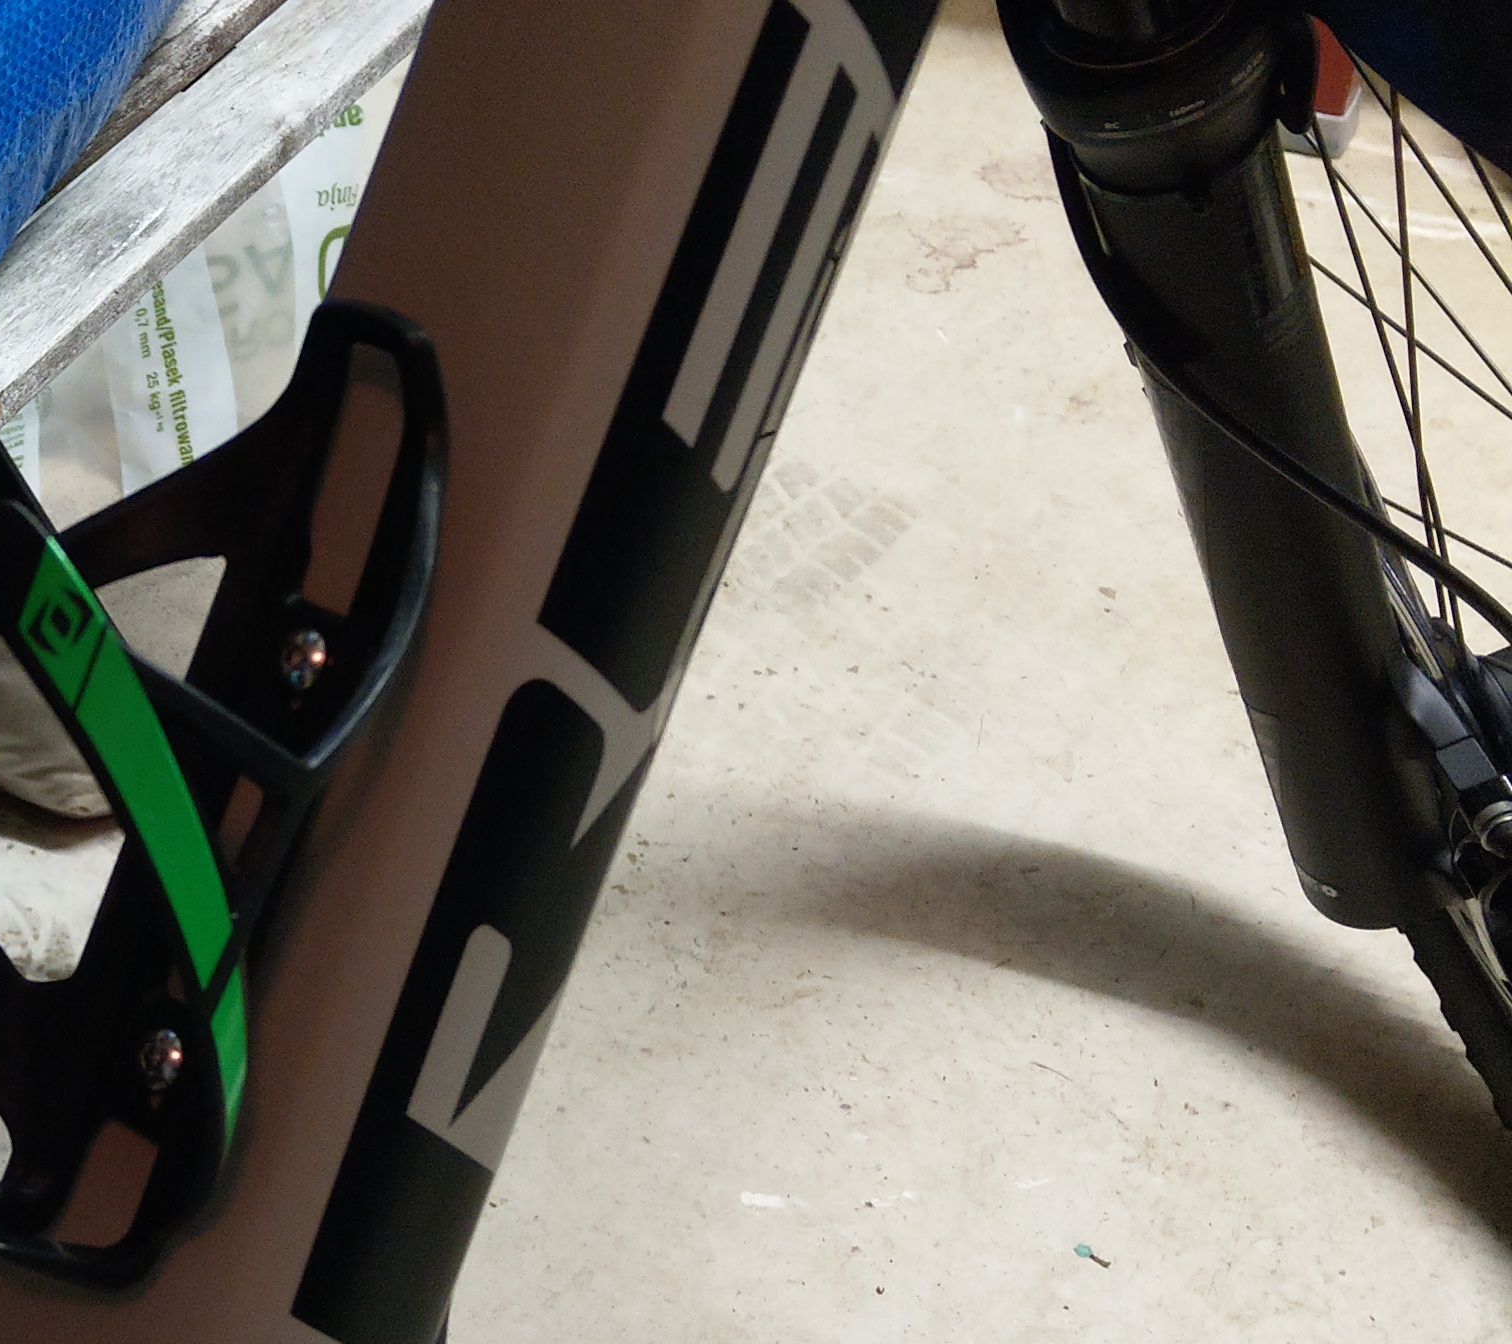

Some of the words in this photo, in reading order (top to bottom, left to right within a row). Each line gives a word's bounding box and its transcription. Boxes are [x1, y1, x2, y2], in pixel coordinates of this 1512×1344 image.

[134, 307, 149, 327] 0,7
[139, 332, 152, 359] mm
[145, 371, 160, 390] 25
[148, 390, 162, 413] kg
